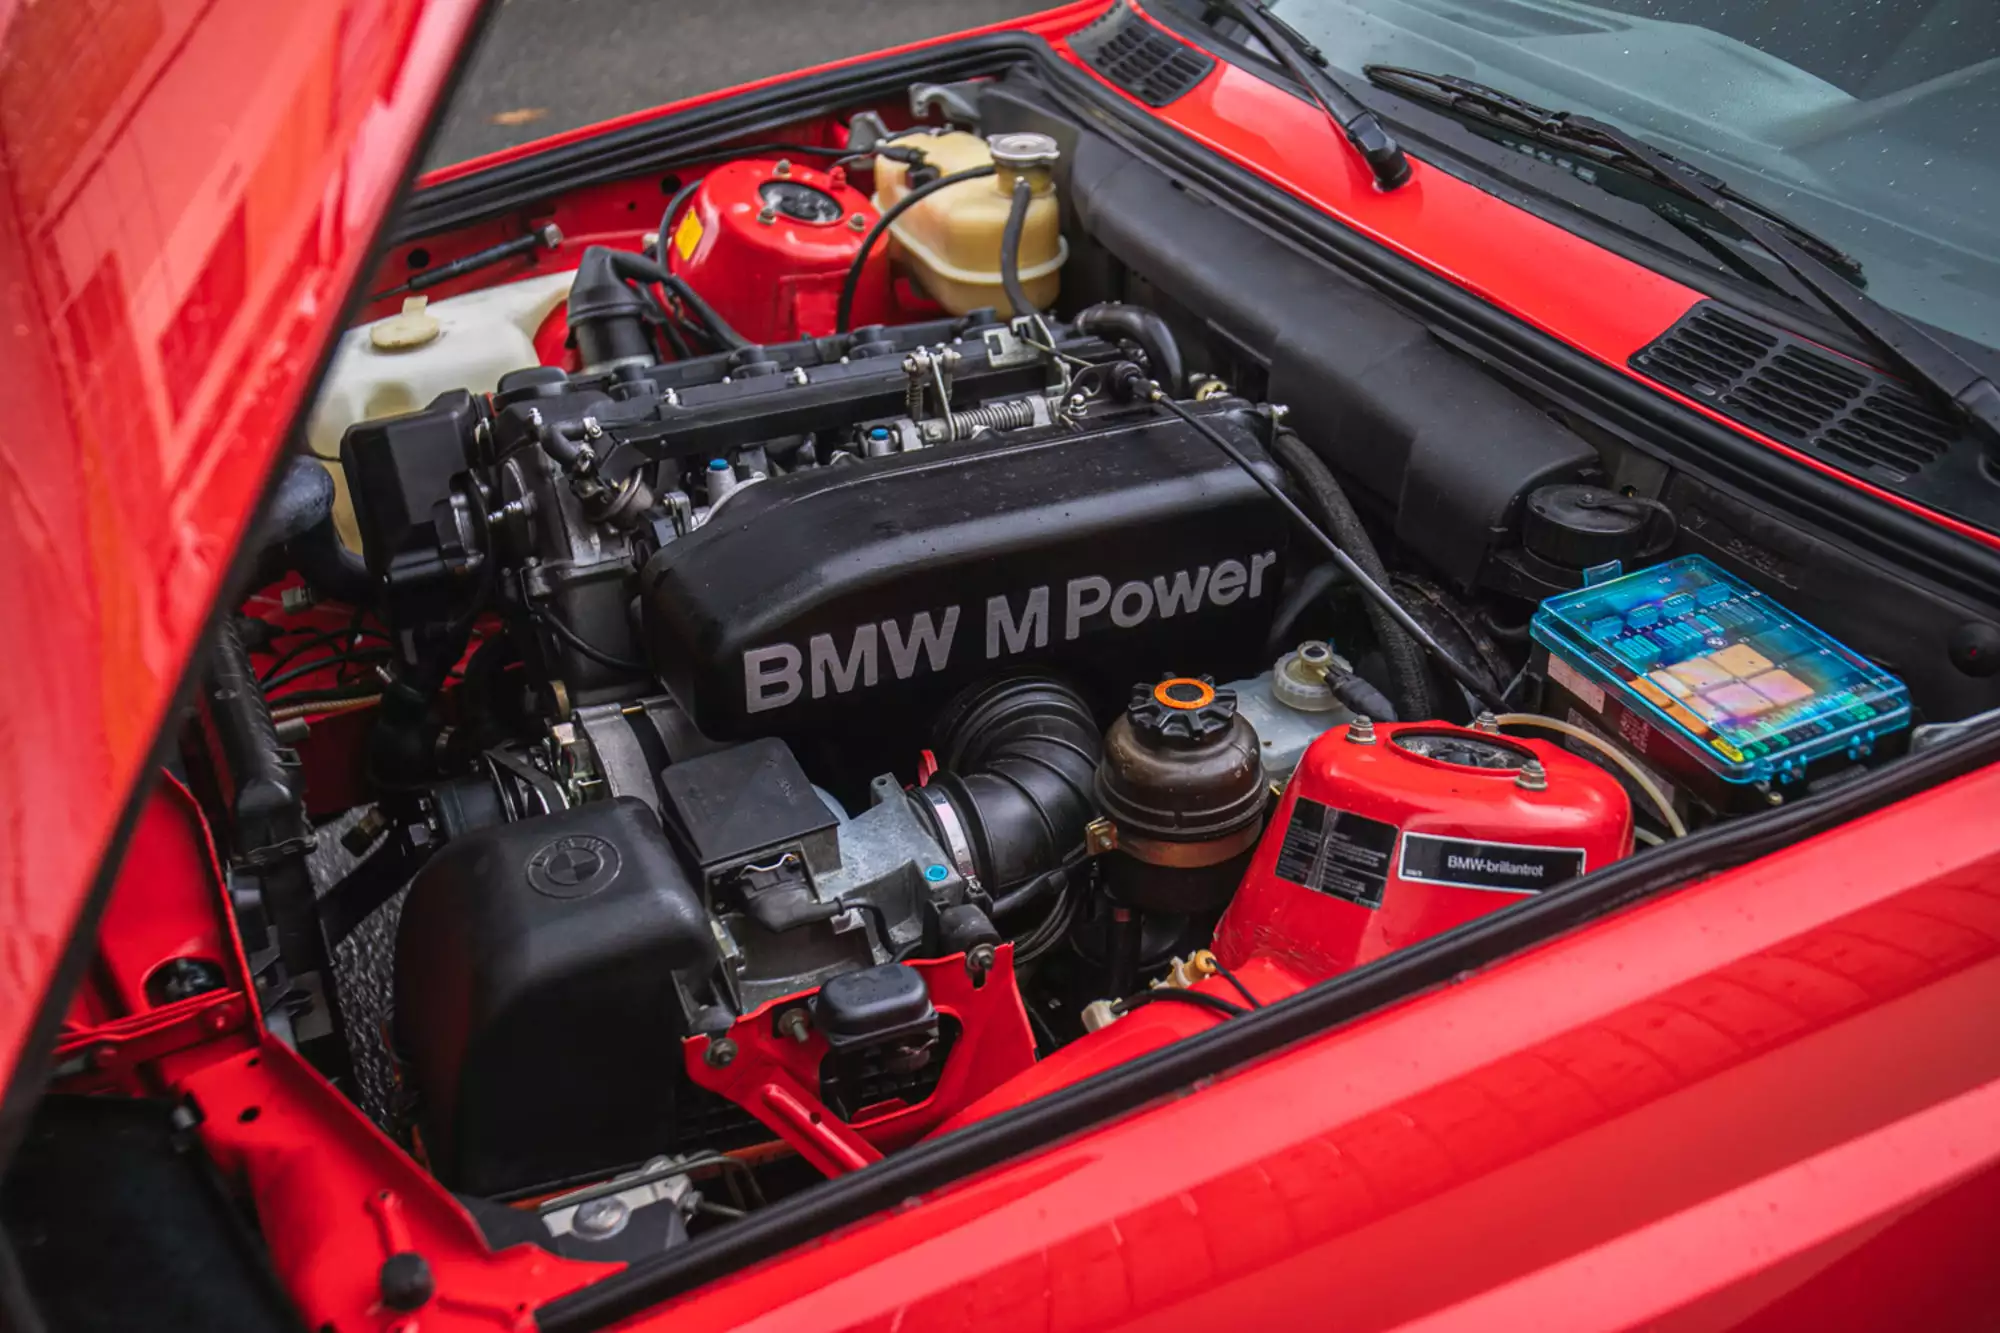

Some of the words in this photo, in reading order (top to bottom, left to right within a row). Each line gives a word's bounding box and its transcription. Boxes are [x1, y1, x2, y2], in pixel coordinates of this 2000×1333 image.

[744, 605, 960, 713] BMW
[985, 585, 1050, 659] M
[1065, 550, 1277, 640] Power
[1447, 854, 1544, 878] BMW-brillantrot
